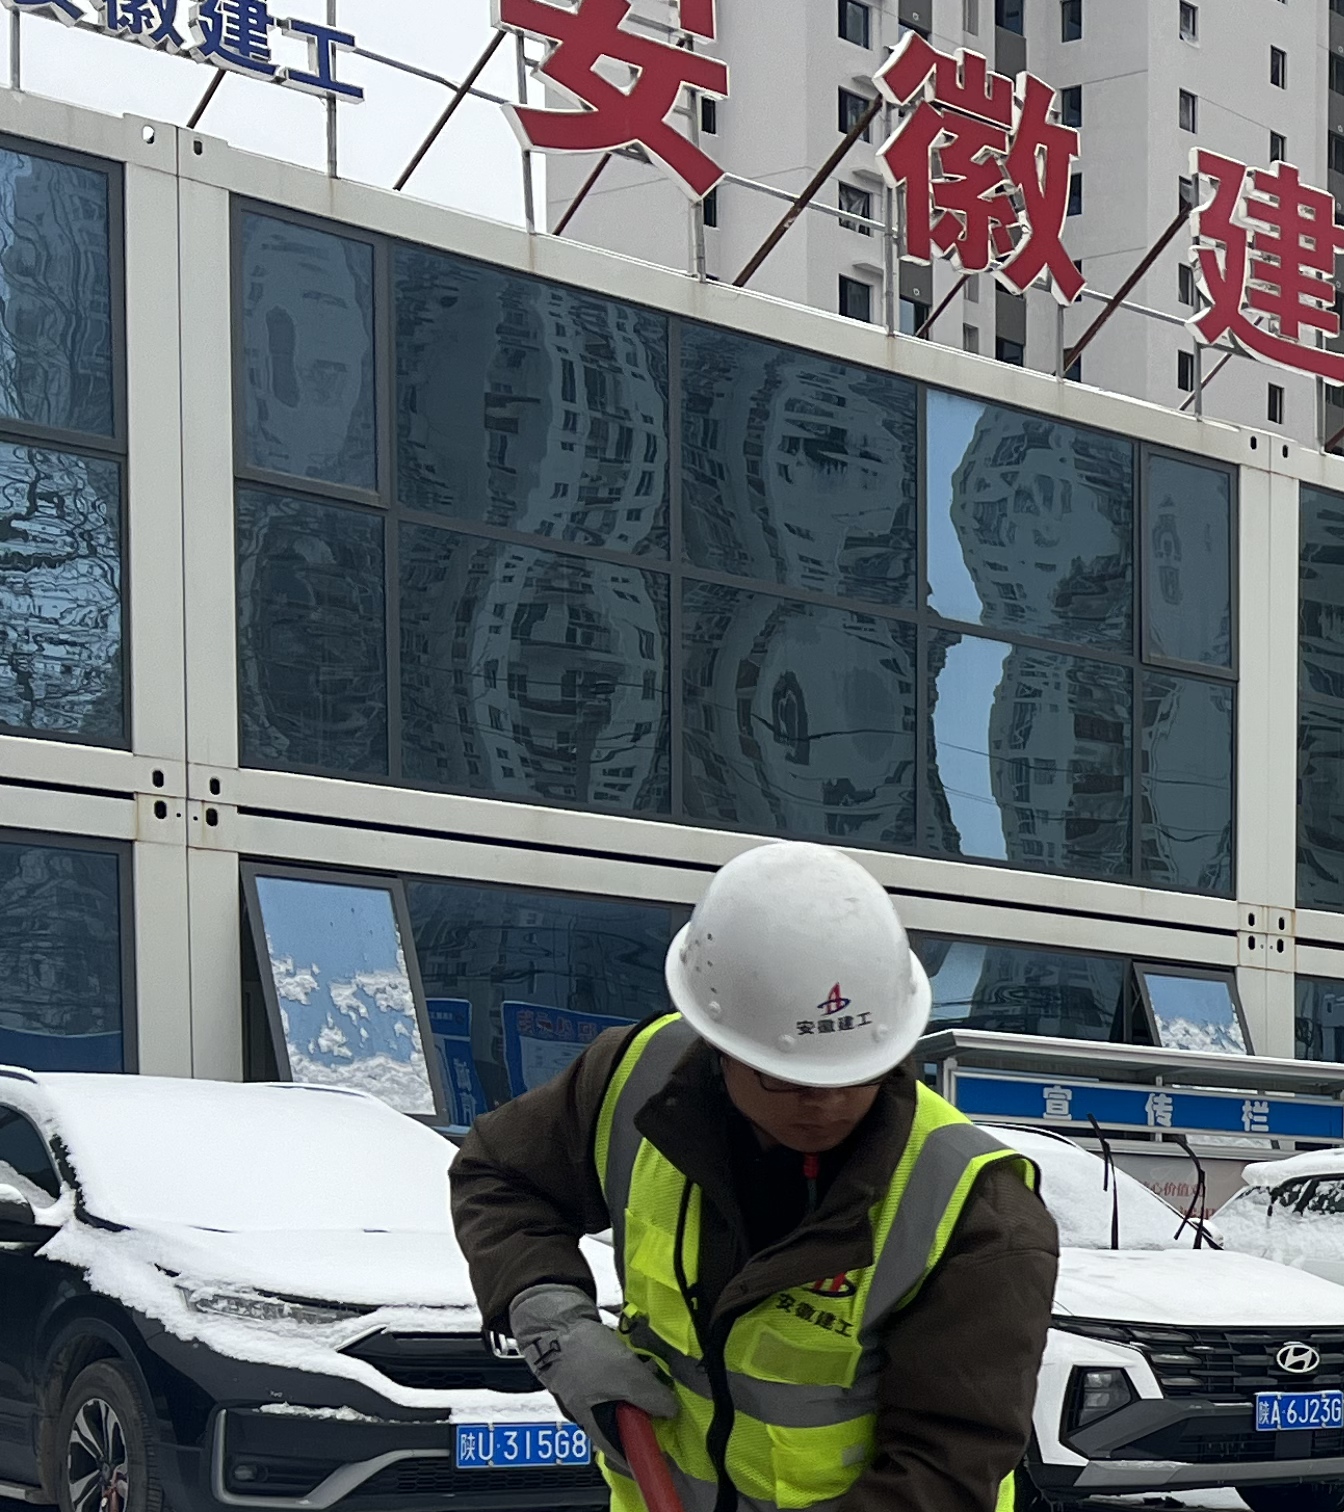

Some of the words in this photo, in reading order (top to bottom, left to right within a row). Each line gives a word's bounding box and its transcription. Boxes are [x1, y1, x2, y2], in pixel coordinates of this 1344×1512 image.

[796, 1011, 873, 1035] 安徽建工
[1043, 1084, 1270, 1133] 宣传栏
[776, 1292, 854, 1337] 安徽建工
[460, 1430, 587, 1461] 陕U·315G8
